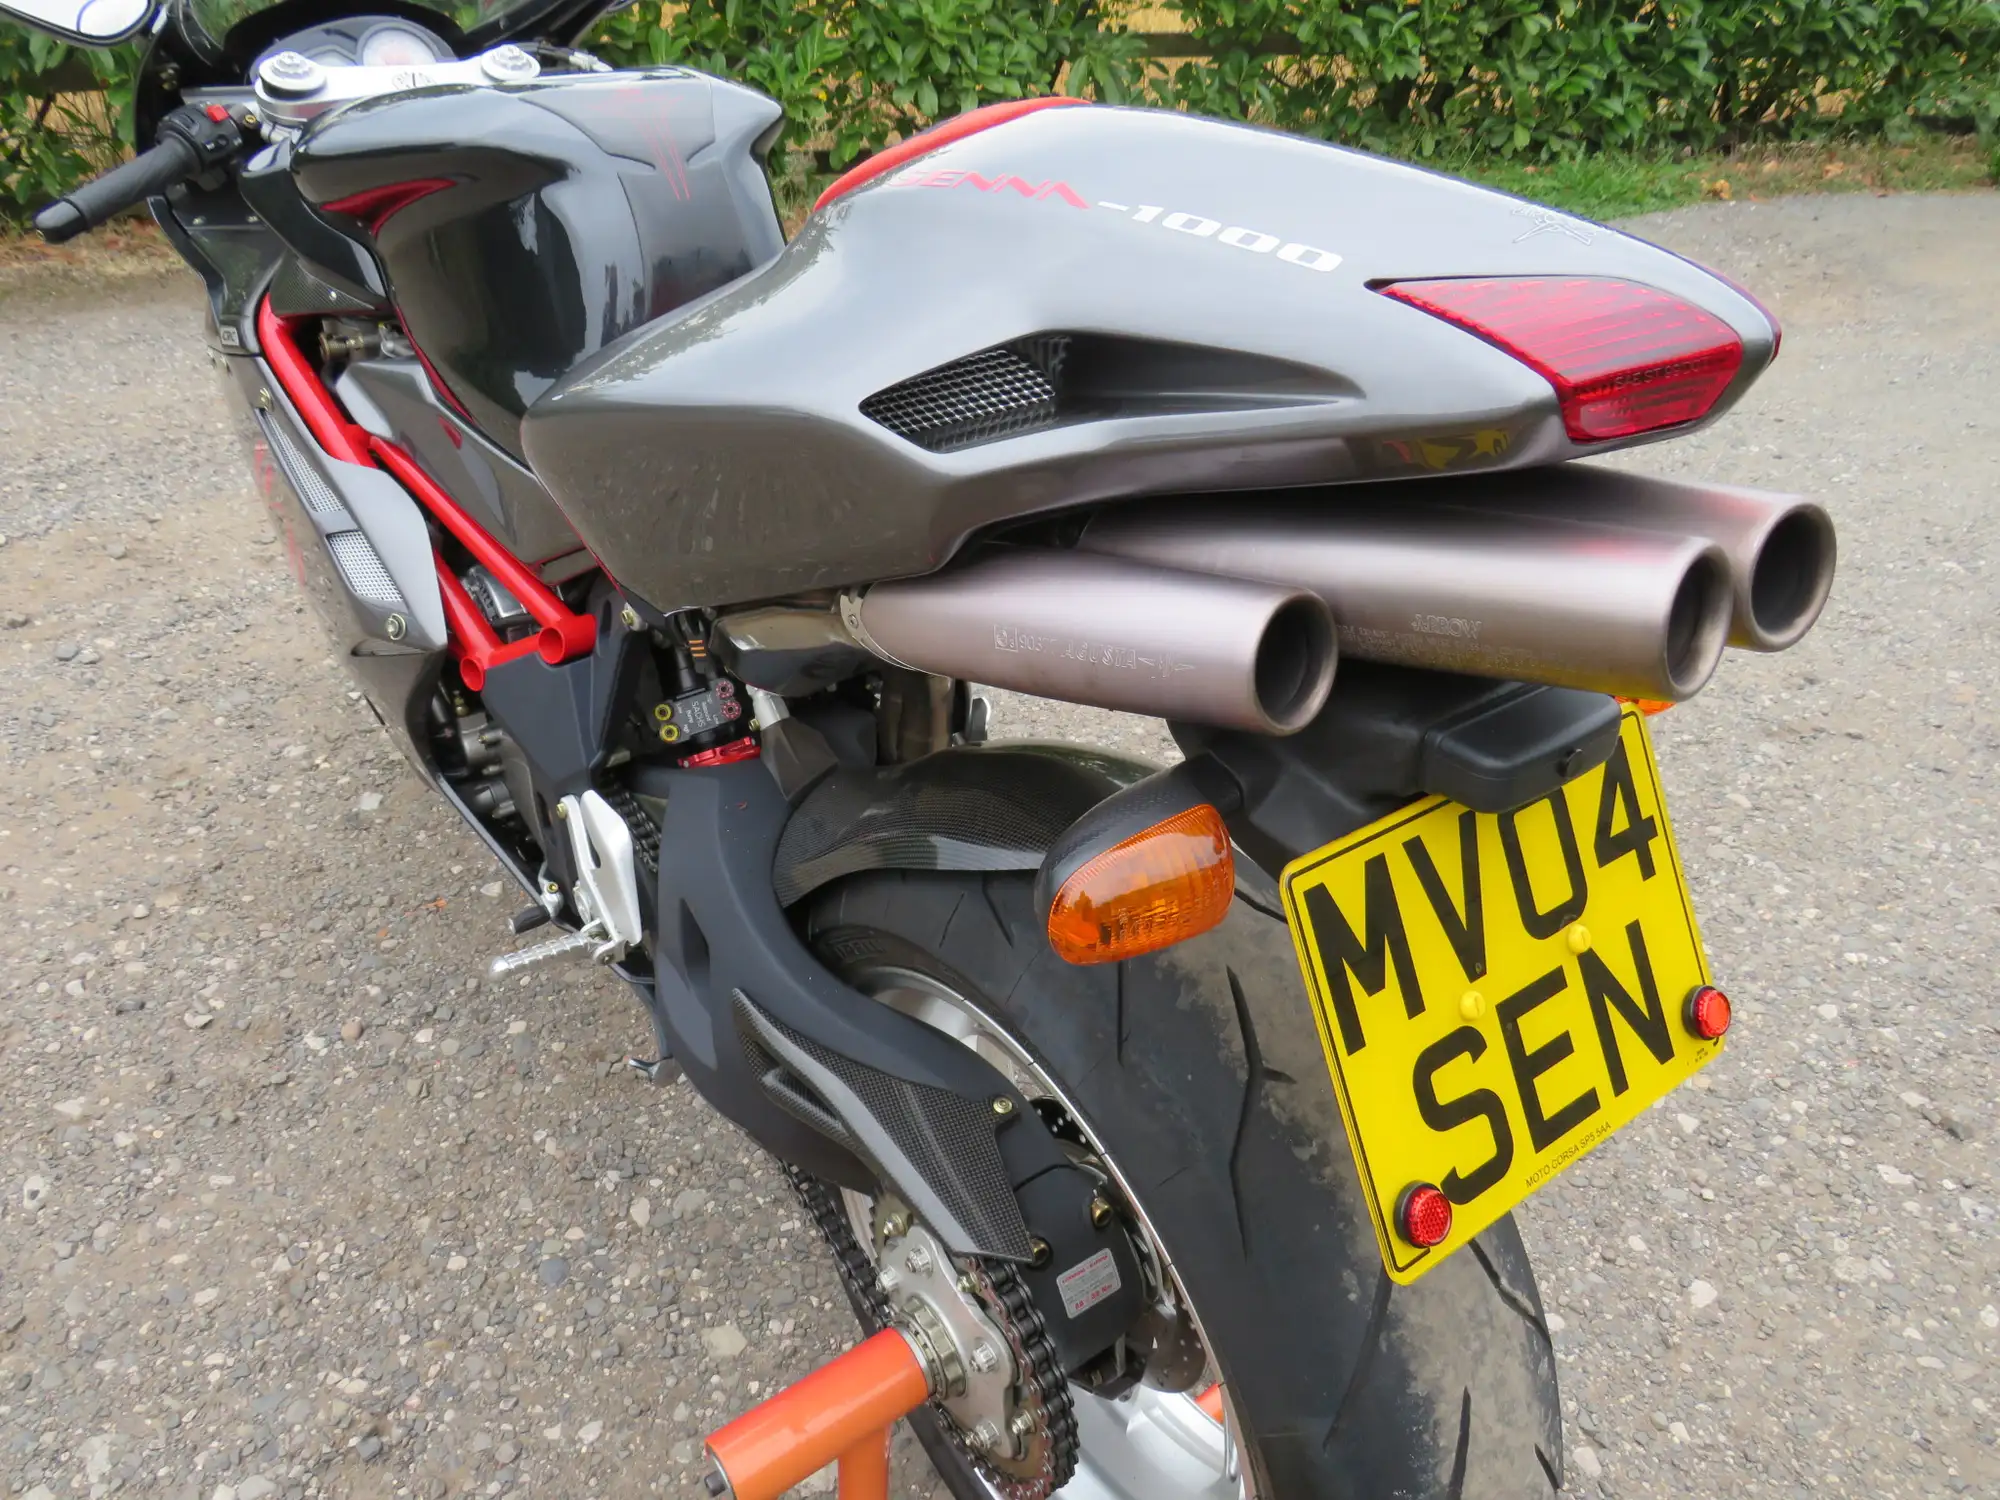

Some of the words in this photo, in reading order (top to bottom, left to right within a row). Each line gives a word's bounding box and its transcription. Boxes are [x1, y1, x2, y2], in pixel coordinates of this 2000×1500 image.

[889, 169, 1091, 210] SENNA
[1411, 613, 1483, 639] ARROW
[691, 700, 706, 728] SACHS
[1303, 735, 1659, 1057] MV04
[1412, 919, 1675, 1206] SEN
[1524, 1165, 1551, 1188] MOTO
[1551, 1144, 1580, 1169] CORSA
[1580, 1132, 1596, 1149] SP5
[1595, 1121, 1612, 1138] 5AA
